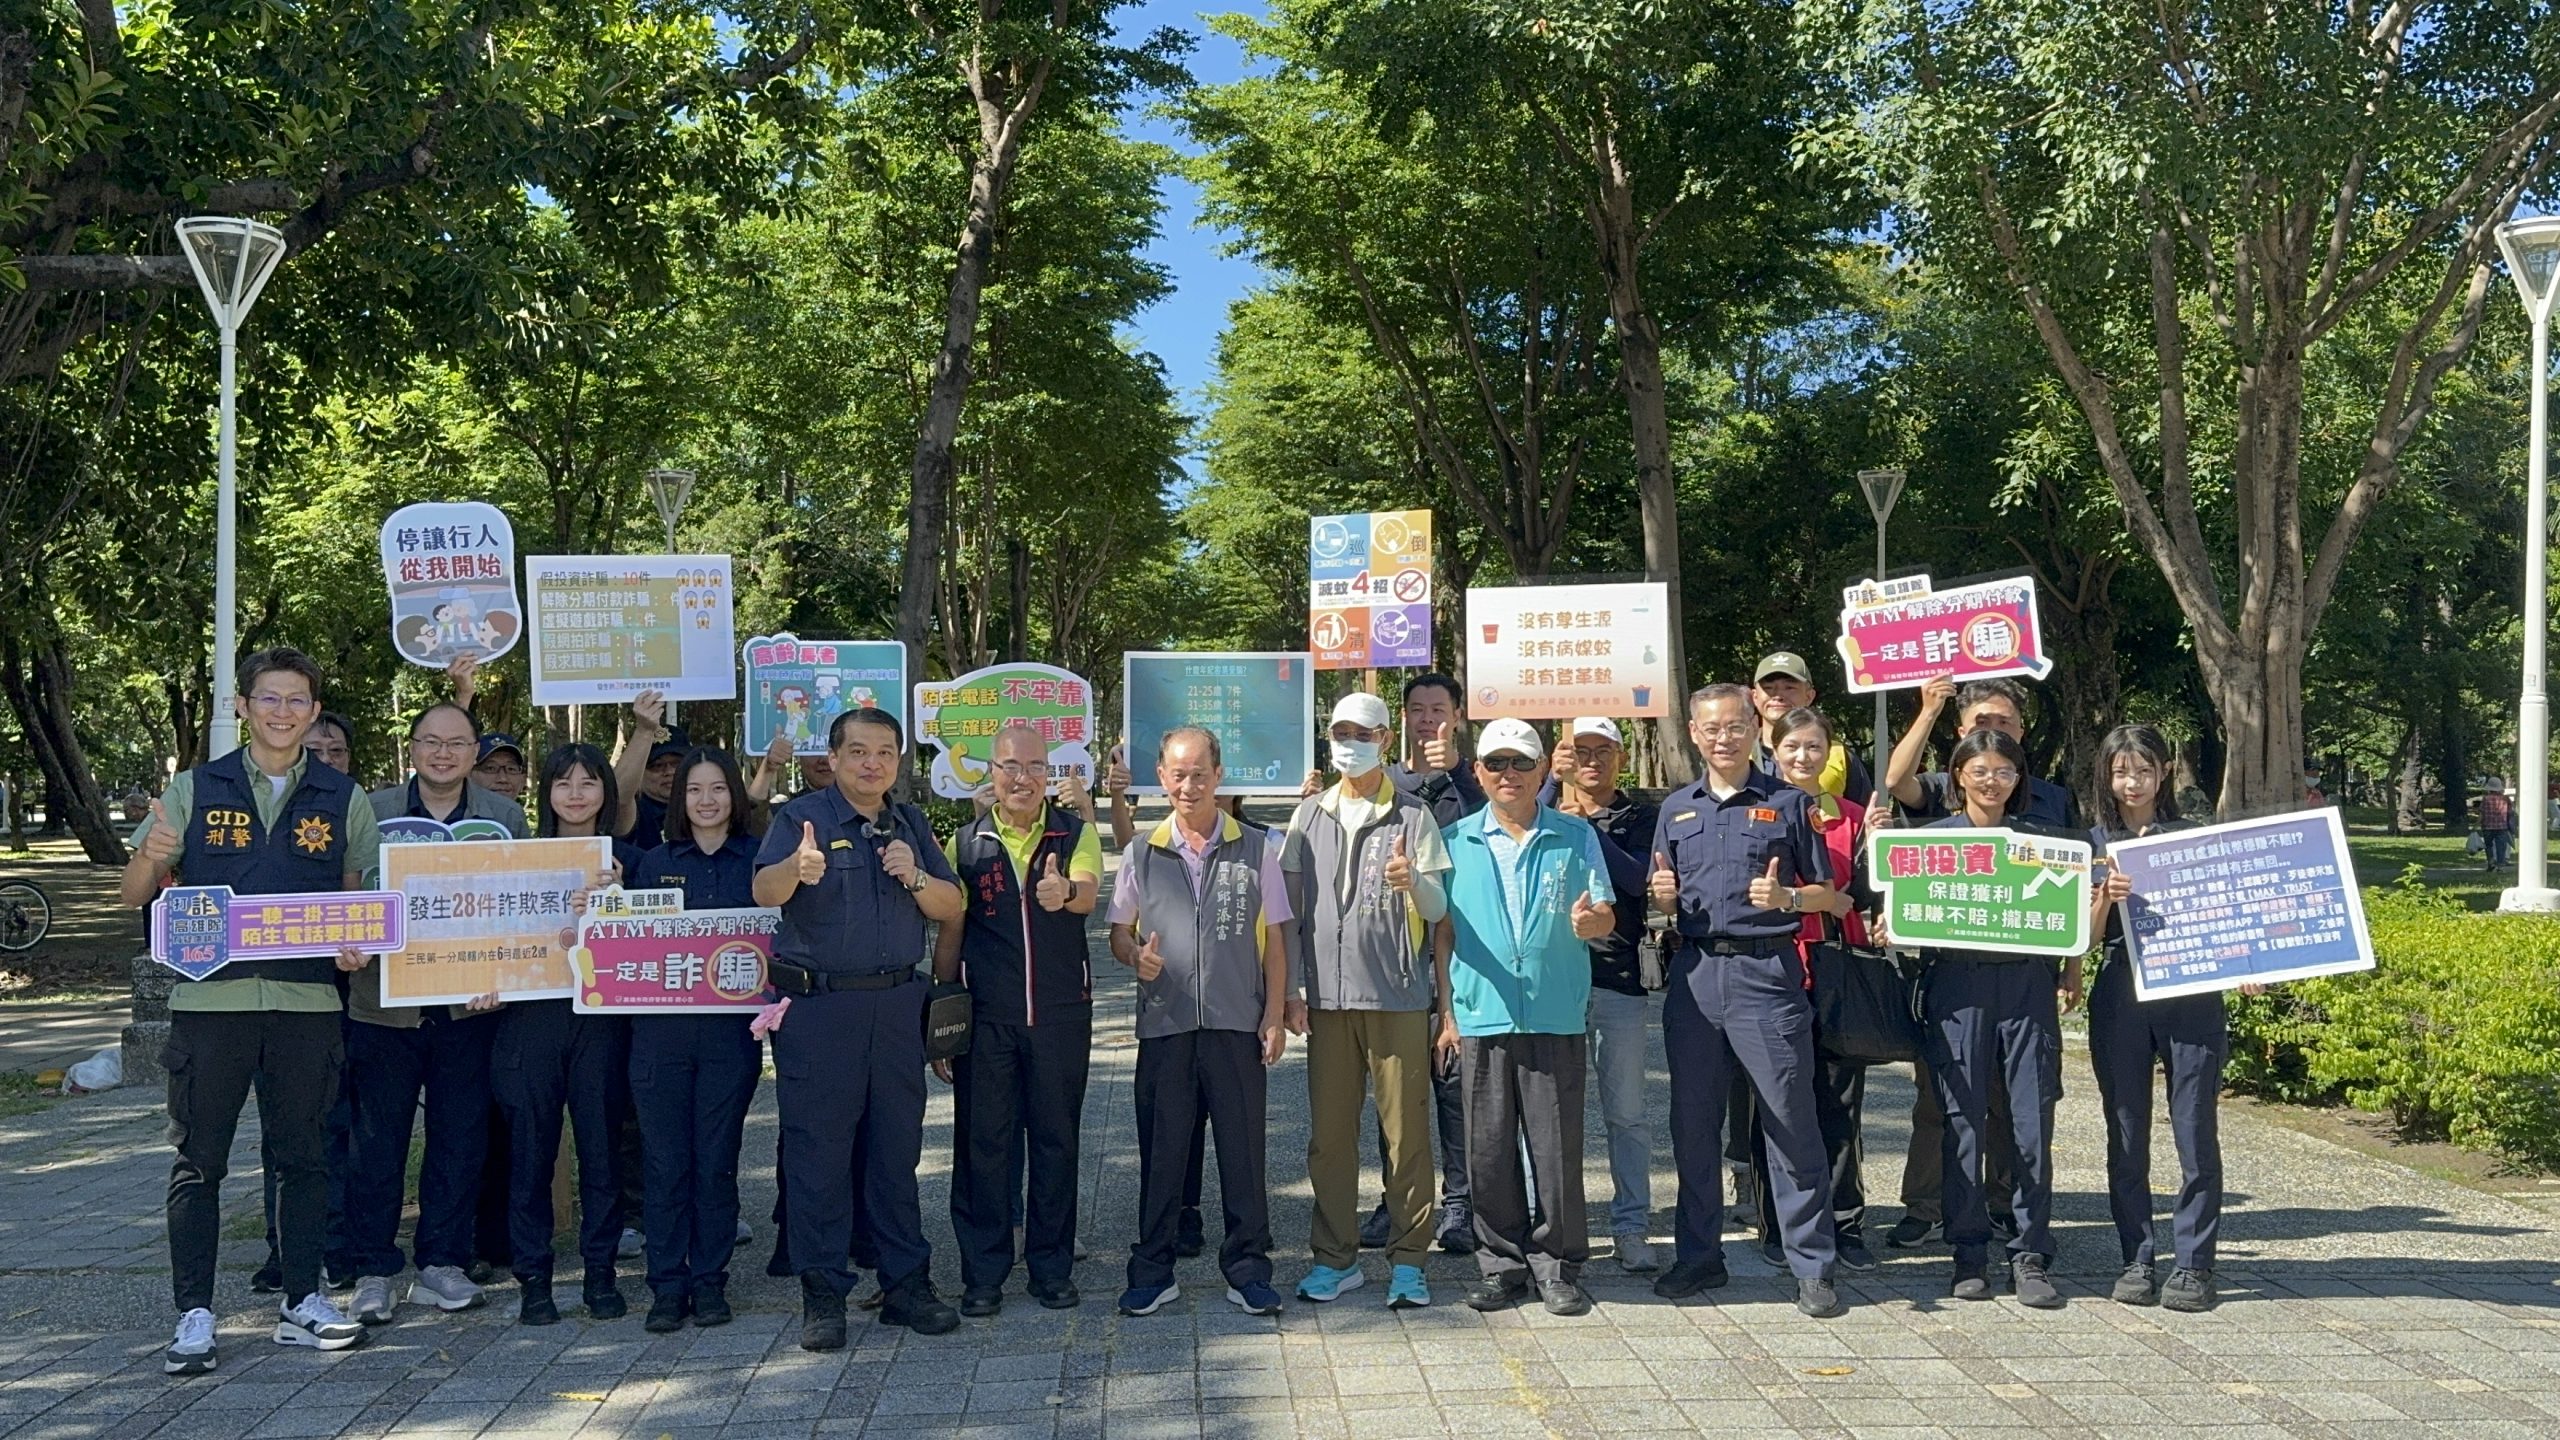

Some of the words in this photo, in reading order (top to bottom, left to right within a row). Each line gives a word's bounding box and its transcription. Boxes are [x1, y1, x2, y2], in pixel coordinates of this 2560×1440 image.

[396, 524, 499, 552] 停讓行人
[1350, 539, 1365, 556] 巡
[1411, 535, 1427, 552] 倒
[399, 553, 502, 582] 從我開始
[540, 570, 652, 587] 假投資詐騙：10件
[1318, 571, 1389, 597] 滅蚊4招
[1848, 588, 1878, 605] 打詐
[1852, 608, 1902, 629] ATM
[1906, 585, 2024, 621] 解除分期付款
[542, 612, 657, 628] 虛擬遊戲詐騙：件
[543, 632, 646, 648] 假網拍詐騙：件
[1350, 632, 1365, 649] 清
[1517, 639, 1612, 658] 沒有病媒蚊
[1860, 620, 2013, 664] 一定是詐騙
[544, 652, 647, 669] 假求職詐騙：件
[752, 642, 838, 668] 高齡長者
[1518, 667, 1613, 687] 沒有登革熱
[921, 687, 998, 707] 陌生電話
[1002, 678, 1085, 707] 不牢靠
[1188, 685, 1222, 697] 21-25歲
[1226, 685, 1242, 697] 7件
[922, 718, 999, 737] 再三確認
[206, 809, 250, 827] CID
[205, 827, 252, 848] 刑警
[1887, 843, 1997, 878] 假投資
[2006, 842, 2036, 862] 打詐
[1927, 881, 2013, 904] 保證獲利
[173, 896, 213, 916] 打詐
[590, 893, 624, 913] 打詐
[631, 893, 676, 908] 高雄隊
[240, 902, 385, 926] 一聽二掛三查證
[1902, 902, 2067, 932] 穩賺不賠，攏是假
[174, 918, 222, 934] 高雄隊
[240, 922, 385, 947] 陌生電話要謹慎
[589, 920, 647, 939] ATM
[652, 915, 779, 938] 解除分期付款
[180, 944, 216, 963] 165
[406, 945, 548, 966] 三民第一分局轄內在6月最近2週
[593, 951, 758, 991] 一定是詐騙
[934, 1022, 966, 1038] MIPRO
